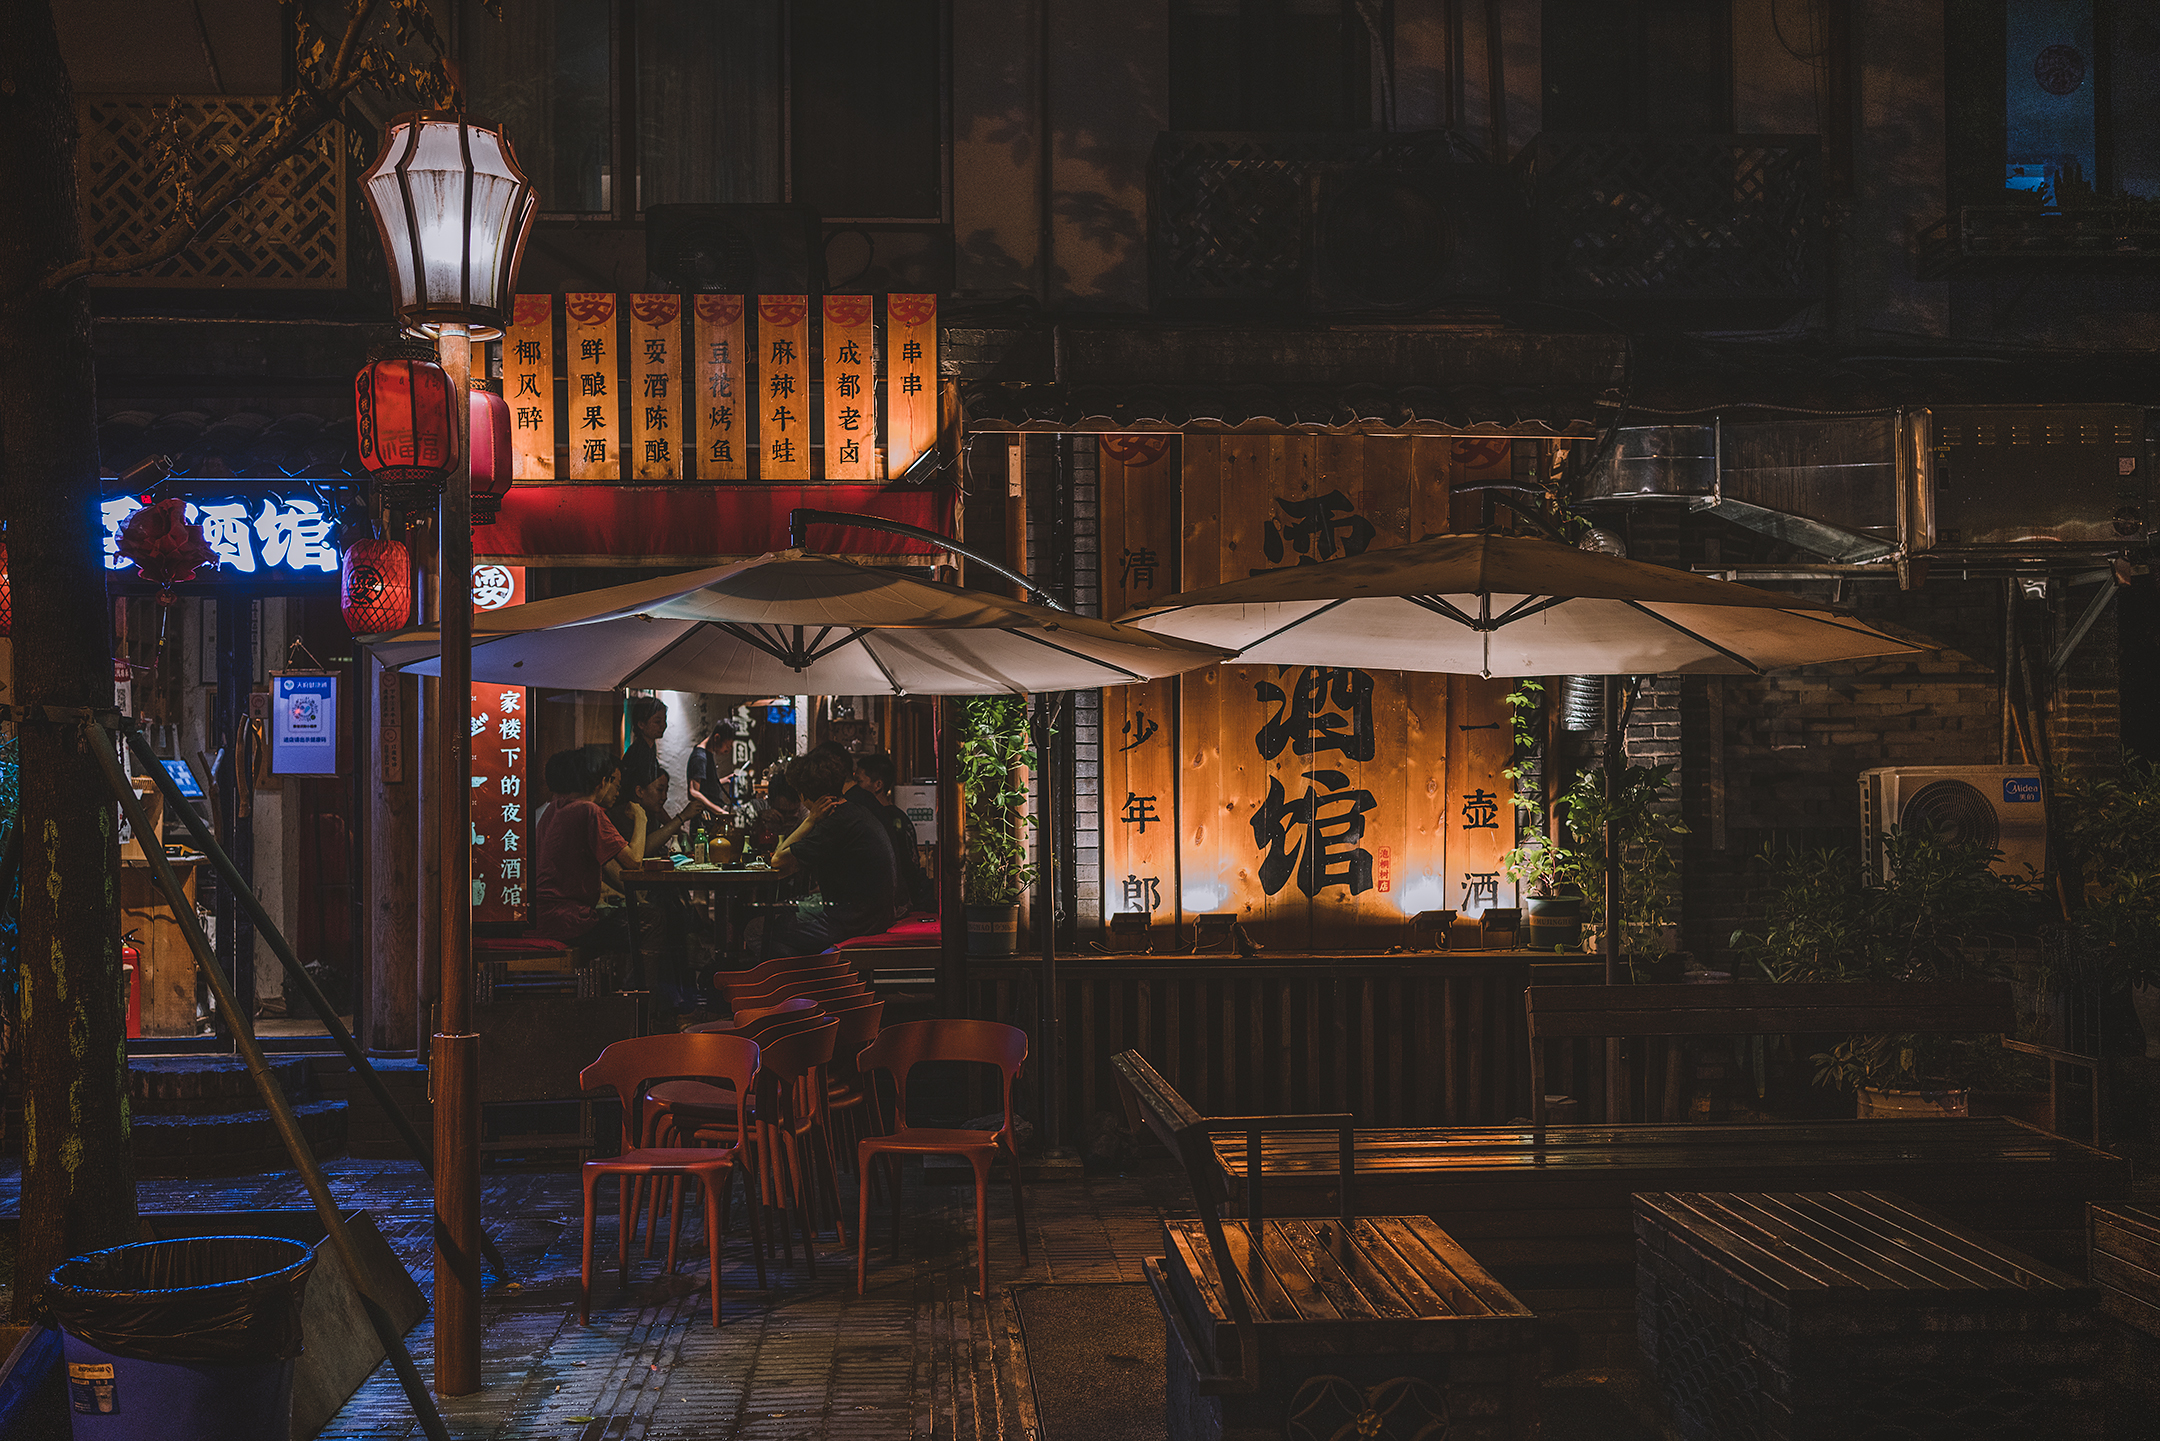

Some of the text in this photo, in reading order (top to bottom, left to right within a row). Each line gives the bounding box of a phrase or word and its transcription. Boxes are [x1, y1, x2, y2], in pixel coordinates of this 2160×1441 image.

[514, 339, 544, 431] 椰风醉
[580, 338, 607, 463] 鲜酿果酒
[644, 338, 671, 463] 耍酒陈酿
[709, 340, 735, 463] 豆花烤鱼
[770, 339, 797, 463] 麻辣牛蛙
[836, 339, 862, 464] 成都老卤
[902, 339, 923, 397] 串串
[499, 690, 523, 907] 家楼下的夜食酒馆
[2008, 781, 2038, 794] Midea
